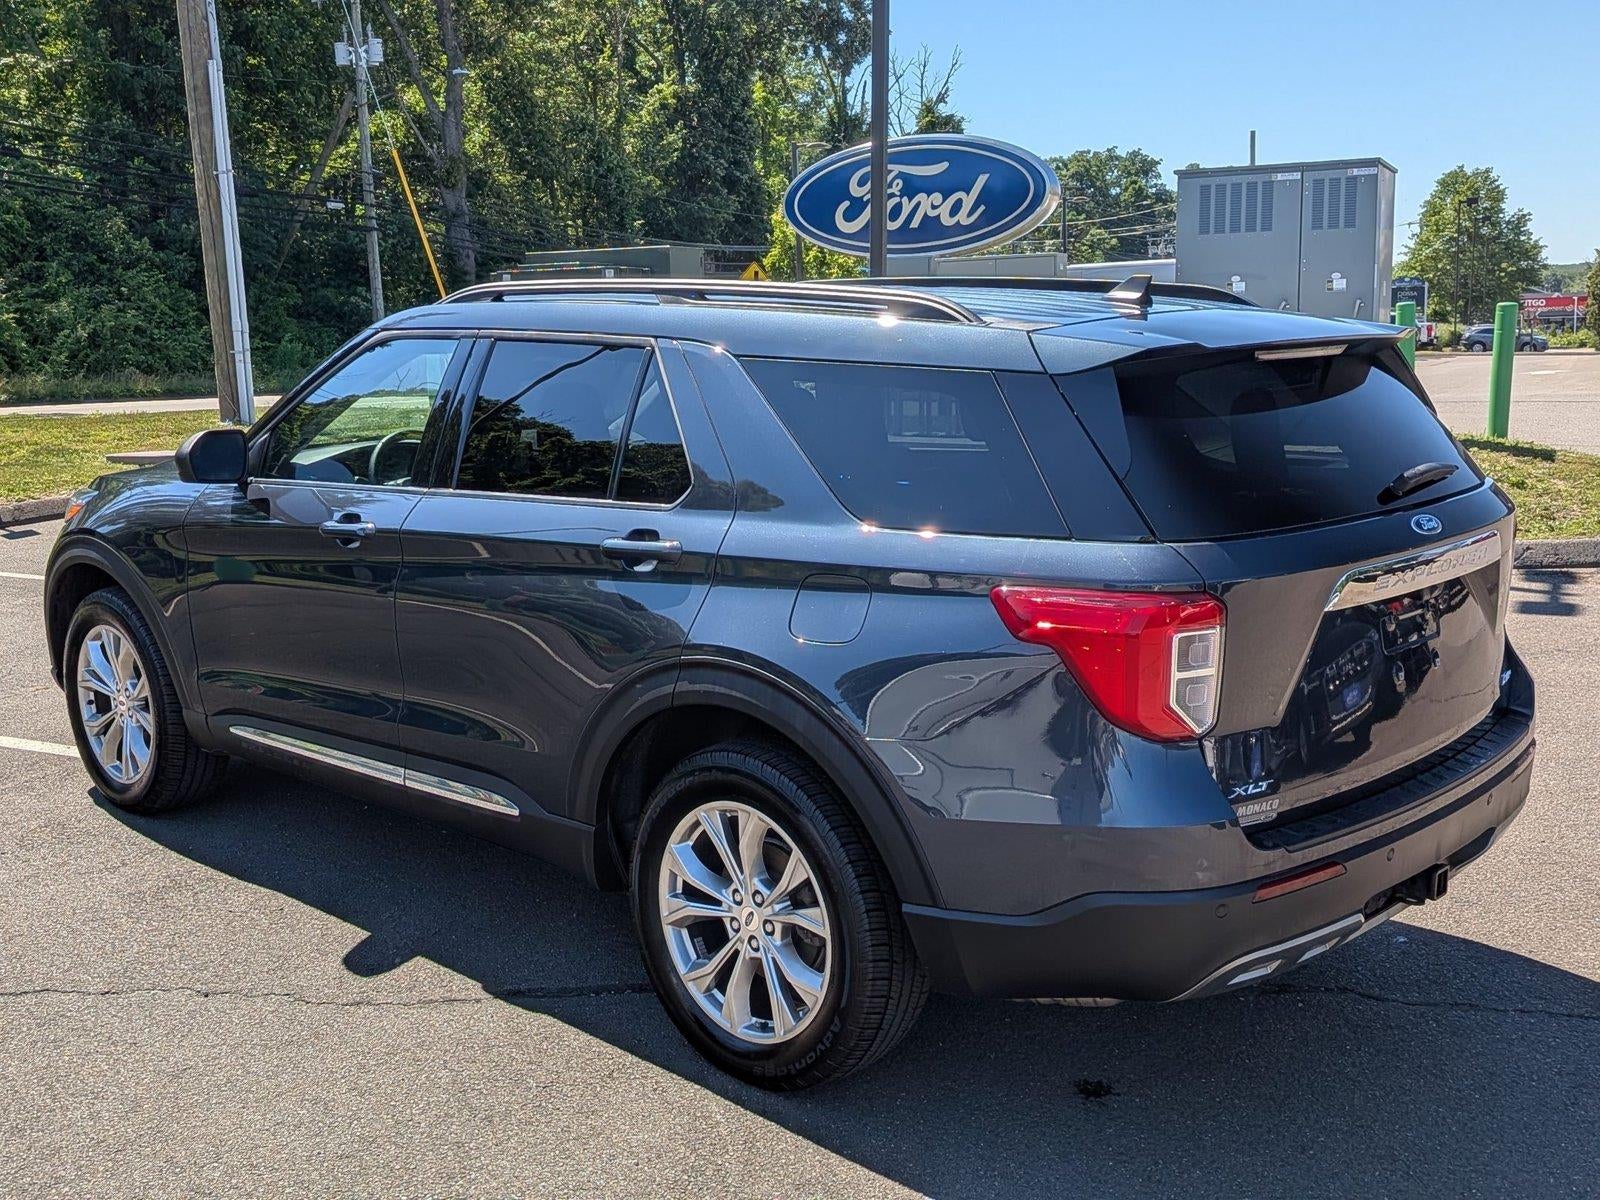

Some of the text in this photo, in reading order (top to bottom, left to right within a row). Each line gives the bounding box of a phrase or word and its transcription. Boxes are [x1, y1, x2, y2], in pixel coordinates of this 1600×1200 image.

[835, 161, 990, 234] Ford
[1420, 516, 1438, 530] Ford
[1374, 547, 1488, 591] EXPLORER
[1228, 779, 1274, 799] XLT
[1237, 799, 1280, 817] MONACO
